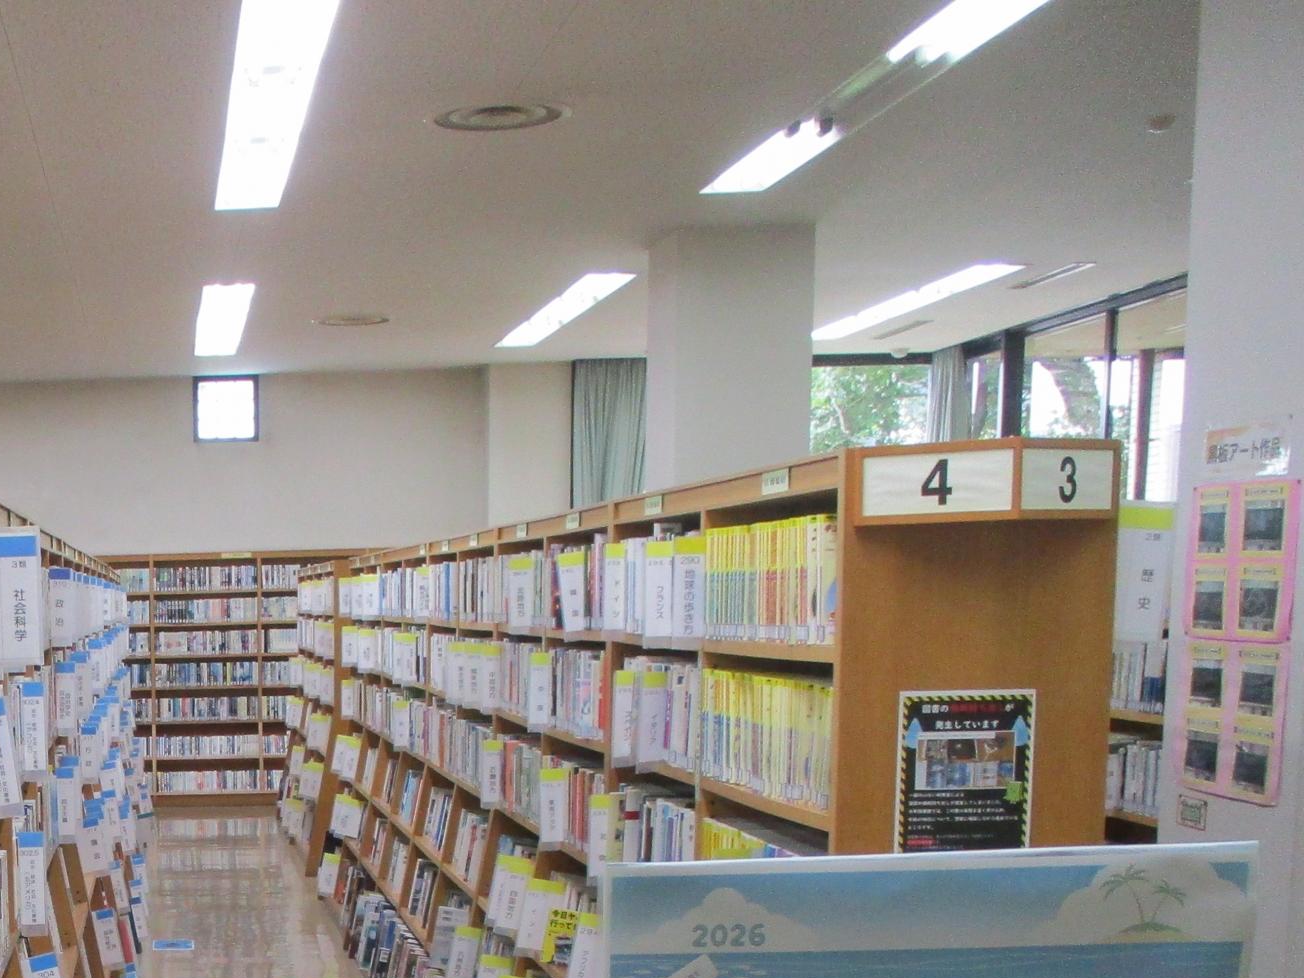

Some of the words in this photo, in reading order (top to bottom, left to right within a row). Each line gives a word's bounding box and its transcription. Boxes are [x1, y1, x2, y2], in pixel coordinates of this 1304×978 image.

[920, 458, 953, 506] 4
[1059, 456, 1077, 503] 3
[1138, 568, 1155, 611] 歴史
[12, 588, 28, 643] 社会科学
[55, 598, 64, 629] 政治
[692, 923, 766, 950] 2026
